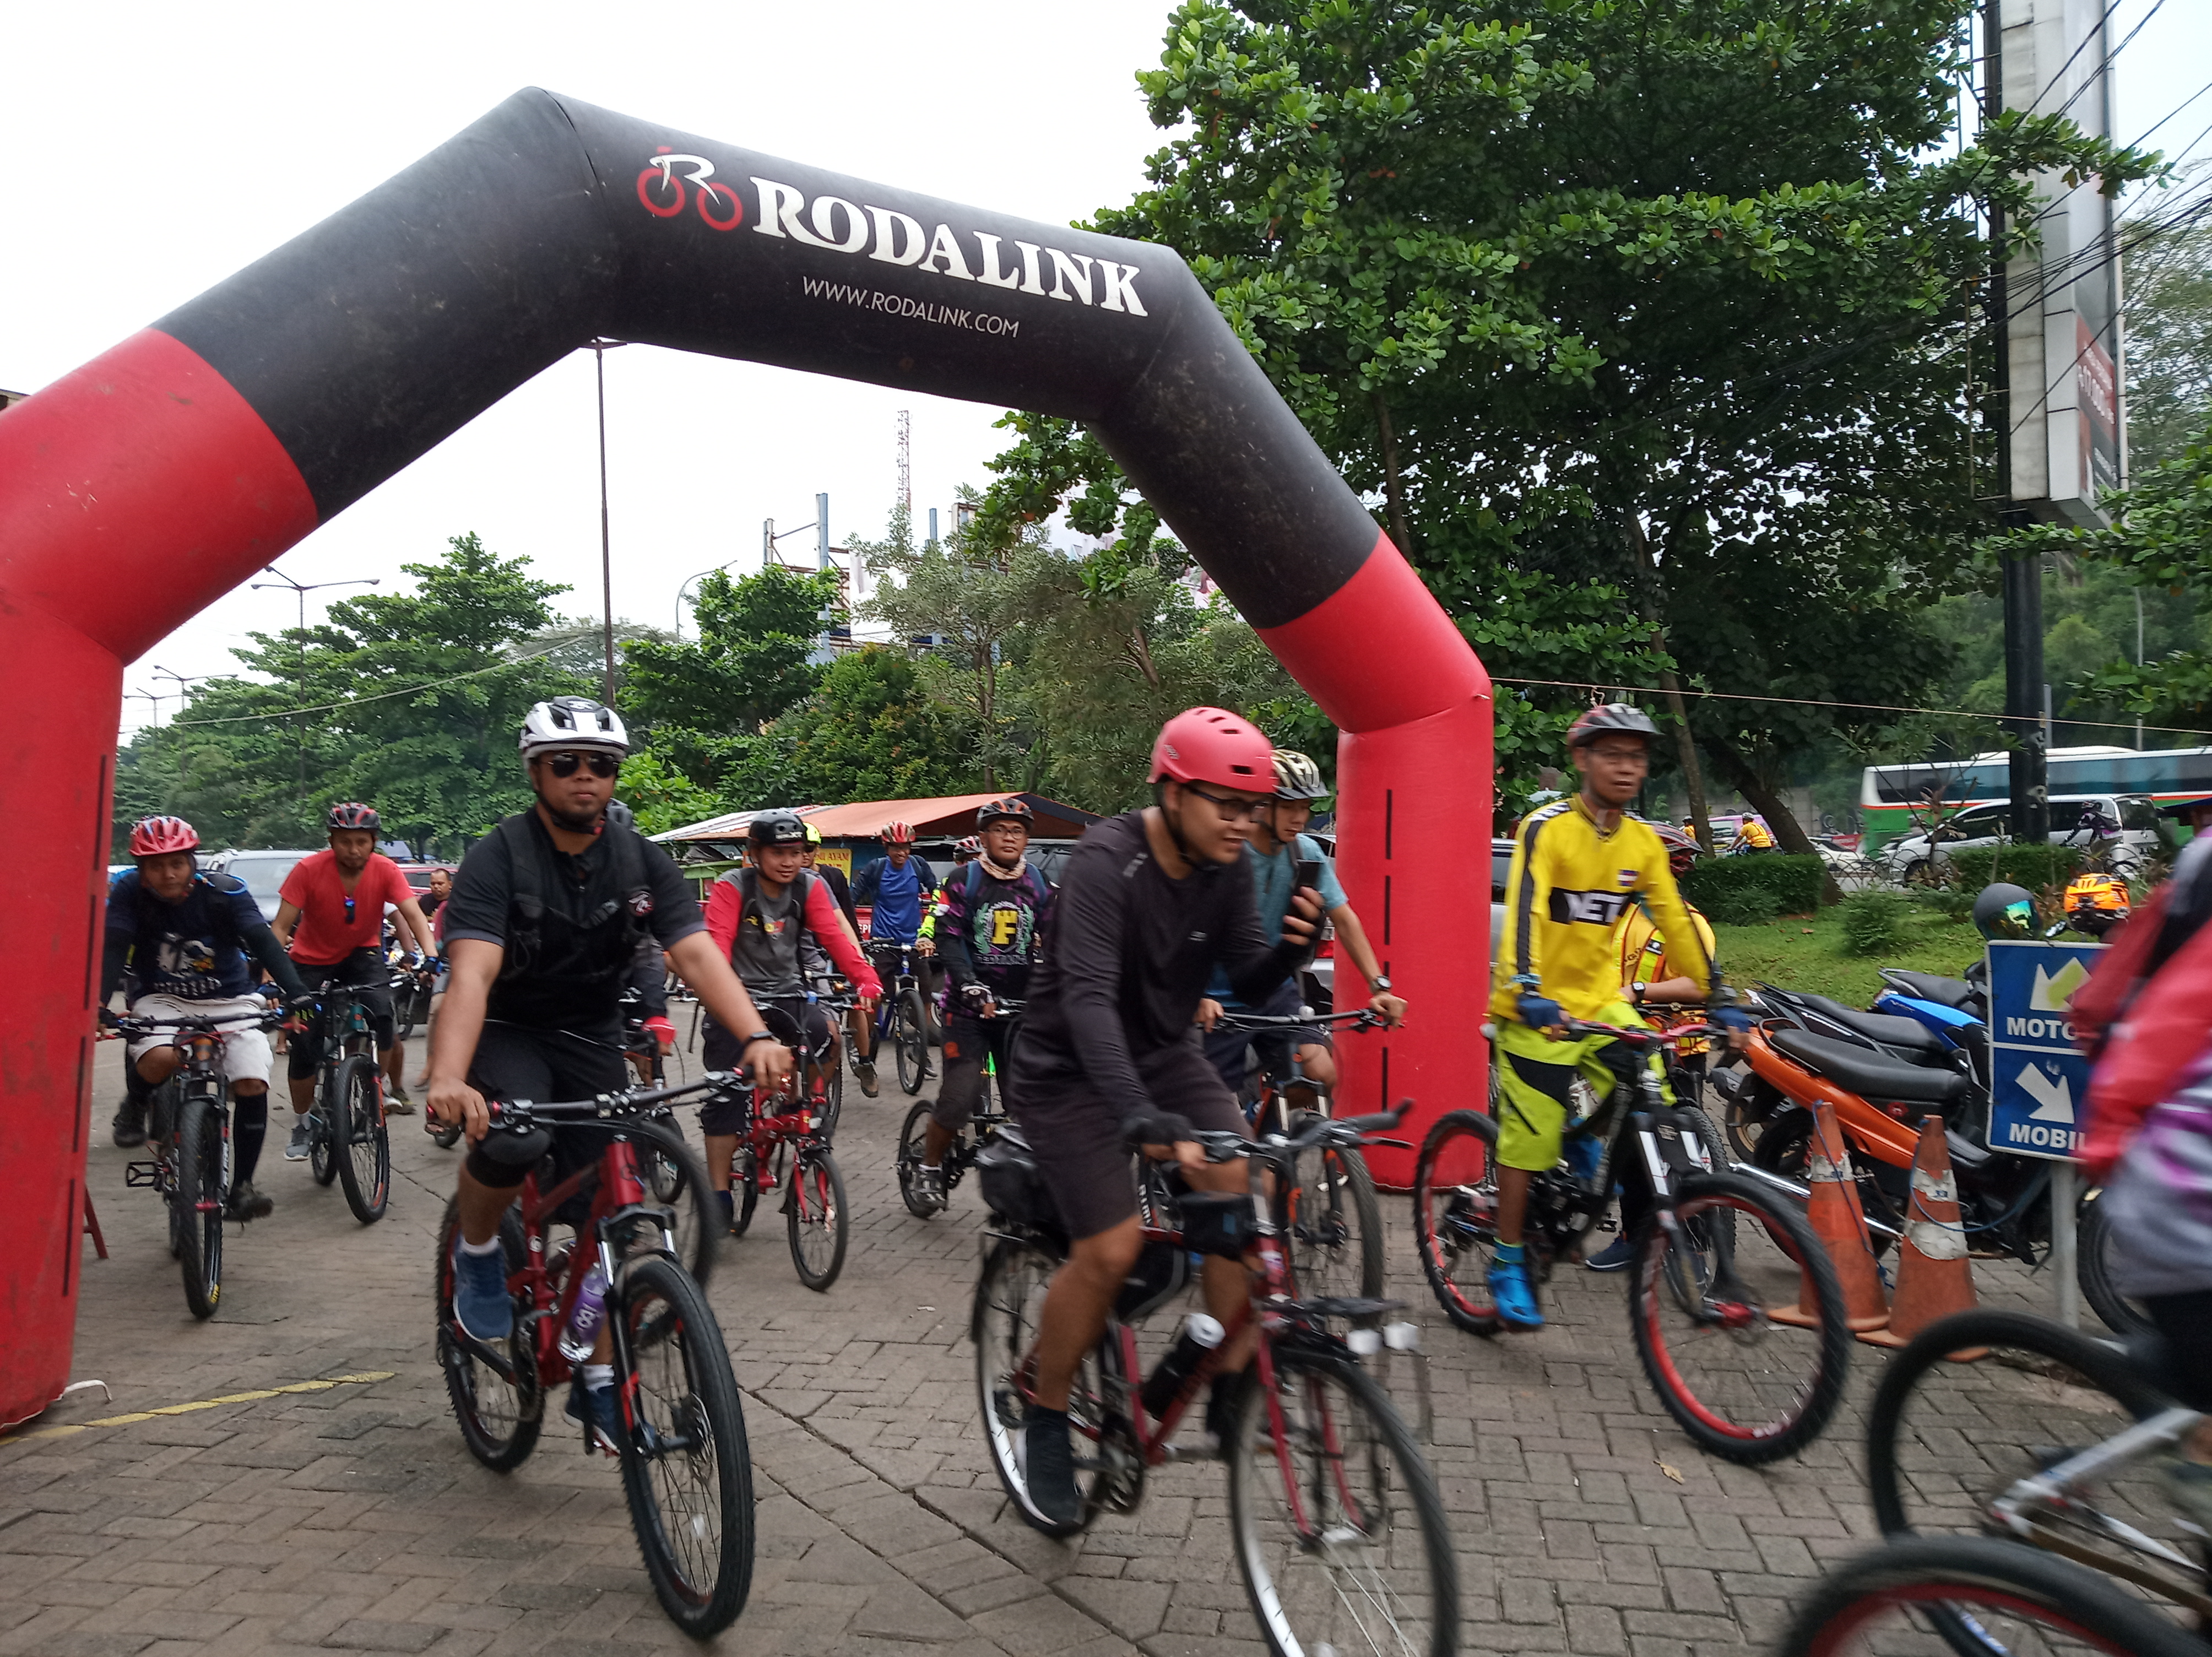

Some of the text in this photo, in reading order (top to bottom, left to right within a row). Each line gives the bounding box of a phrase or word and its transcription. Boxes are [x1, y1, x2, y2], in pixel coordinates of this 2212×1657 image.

[749, 176, 1148, 317] RODALINK
[802, 275, 1020, 339] WWW.RODALINK.COM
[991, 909, 1018, 945] F
[2007, 1016, 2080, 1041] MOTO
